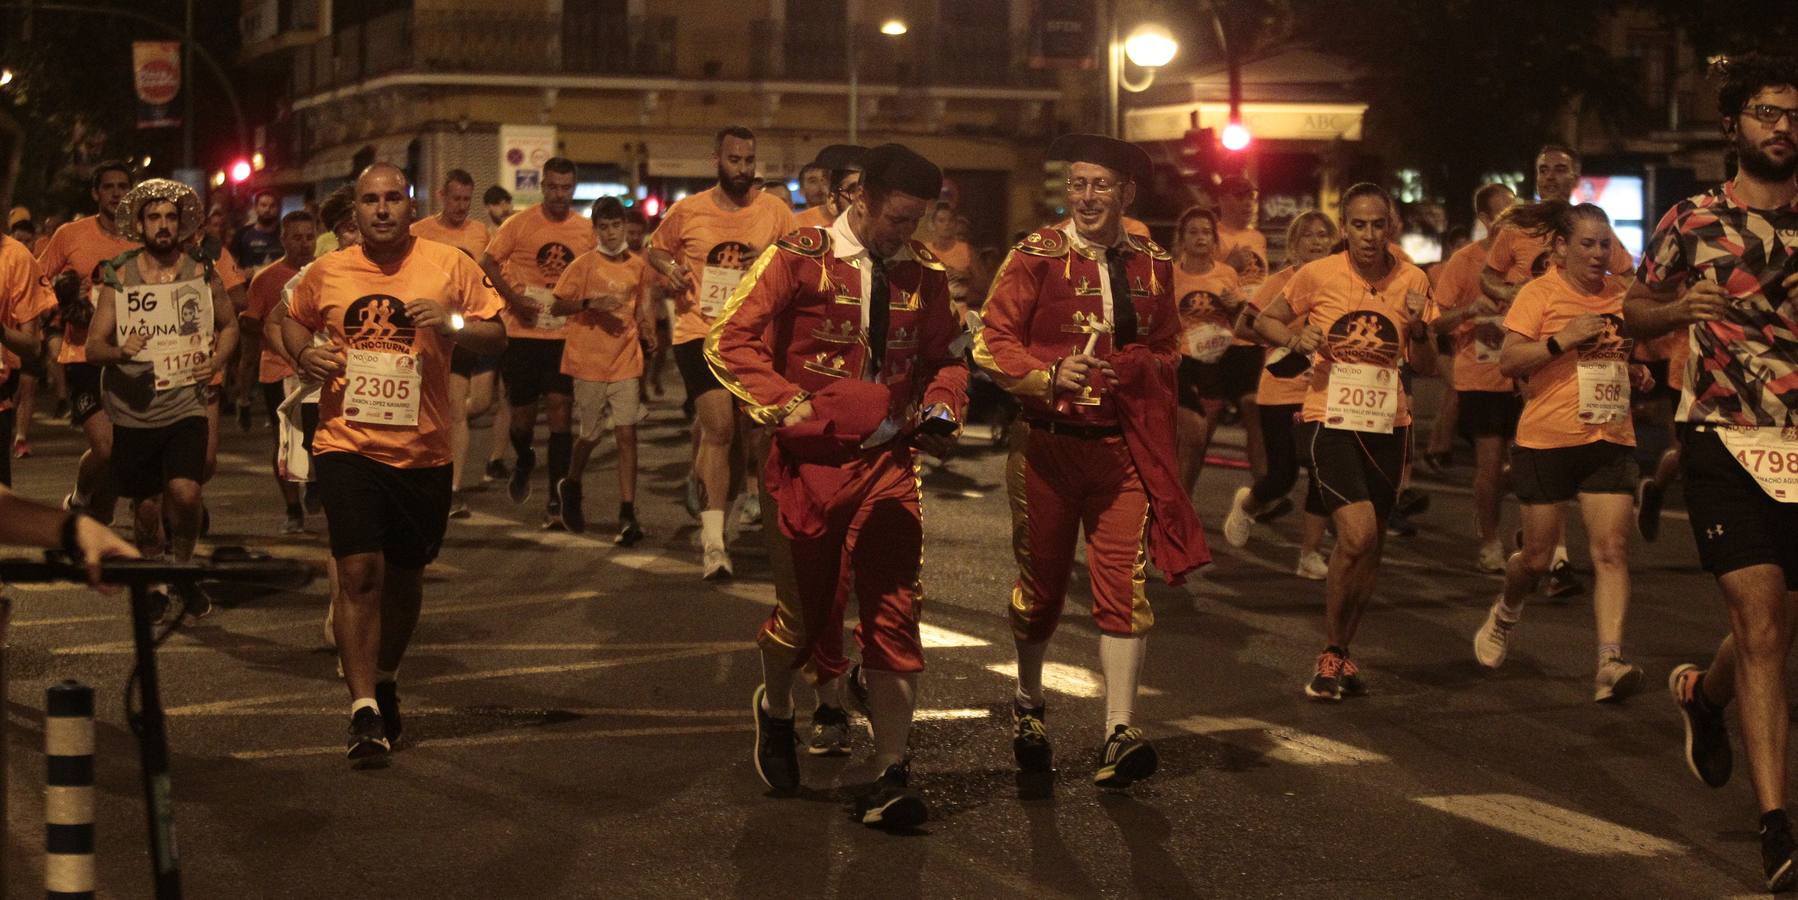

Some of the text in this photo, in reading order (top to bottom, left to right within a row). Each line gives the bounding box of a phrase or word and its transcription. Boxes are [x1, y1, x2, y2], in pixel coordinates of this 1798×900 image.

[1304, 115, 1338, 130] ABC
[127, 290, 158, 312] 5G
[119, 323, 178, 337] VACUNA
[361, 341, 410, 355] NOCTURNA
[354, 375, 411, 401] 2305
[1338, 387, 1388, 409] 2037
[1594, 383, 1622, 402] 568
[1736, 450, 1798, 474] 4798
